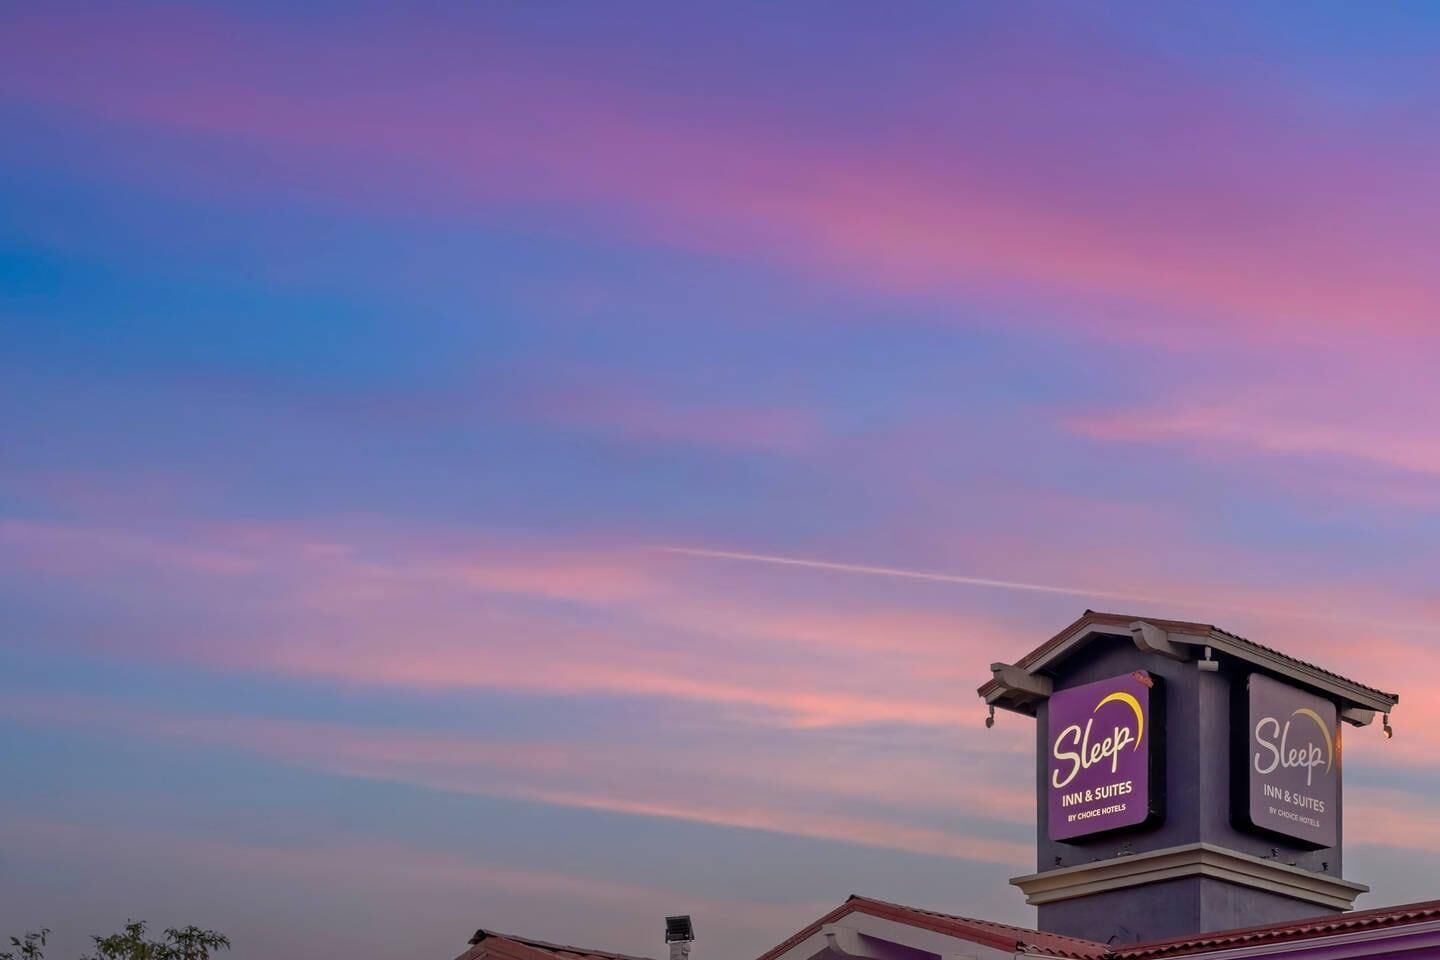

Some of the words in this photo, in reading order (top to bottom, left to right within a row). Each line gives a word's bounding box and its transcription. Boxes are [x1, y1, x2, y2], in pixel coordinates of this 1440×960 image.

[1053, 718, 1134, 788] Sleep
[1254, 717, 1326, 786] Sleep
[1062, 791, 1082, 807] INN
[1085, 790, 1094, 802] &
[1095, 781, 1132, 800] SUITES
[1263, 784, 1282, 800] INN
[1284, 790, 1292, 803] &
[1292, 793, 1325, 813] SUITES
[1068, 814, 1077, 822] BY
[1078, 808, 1101, 820] CHOICE
[1102, 803, 1126, 815] HOTELS
[1269, 806, 1277, 815] BY
[1278, 809, 1299, 822] CHOICE
[1299, 815, 1320, 828] HOTELS
